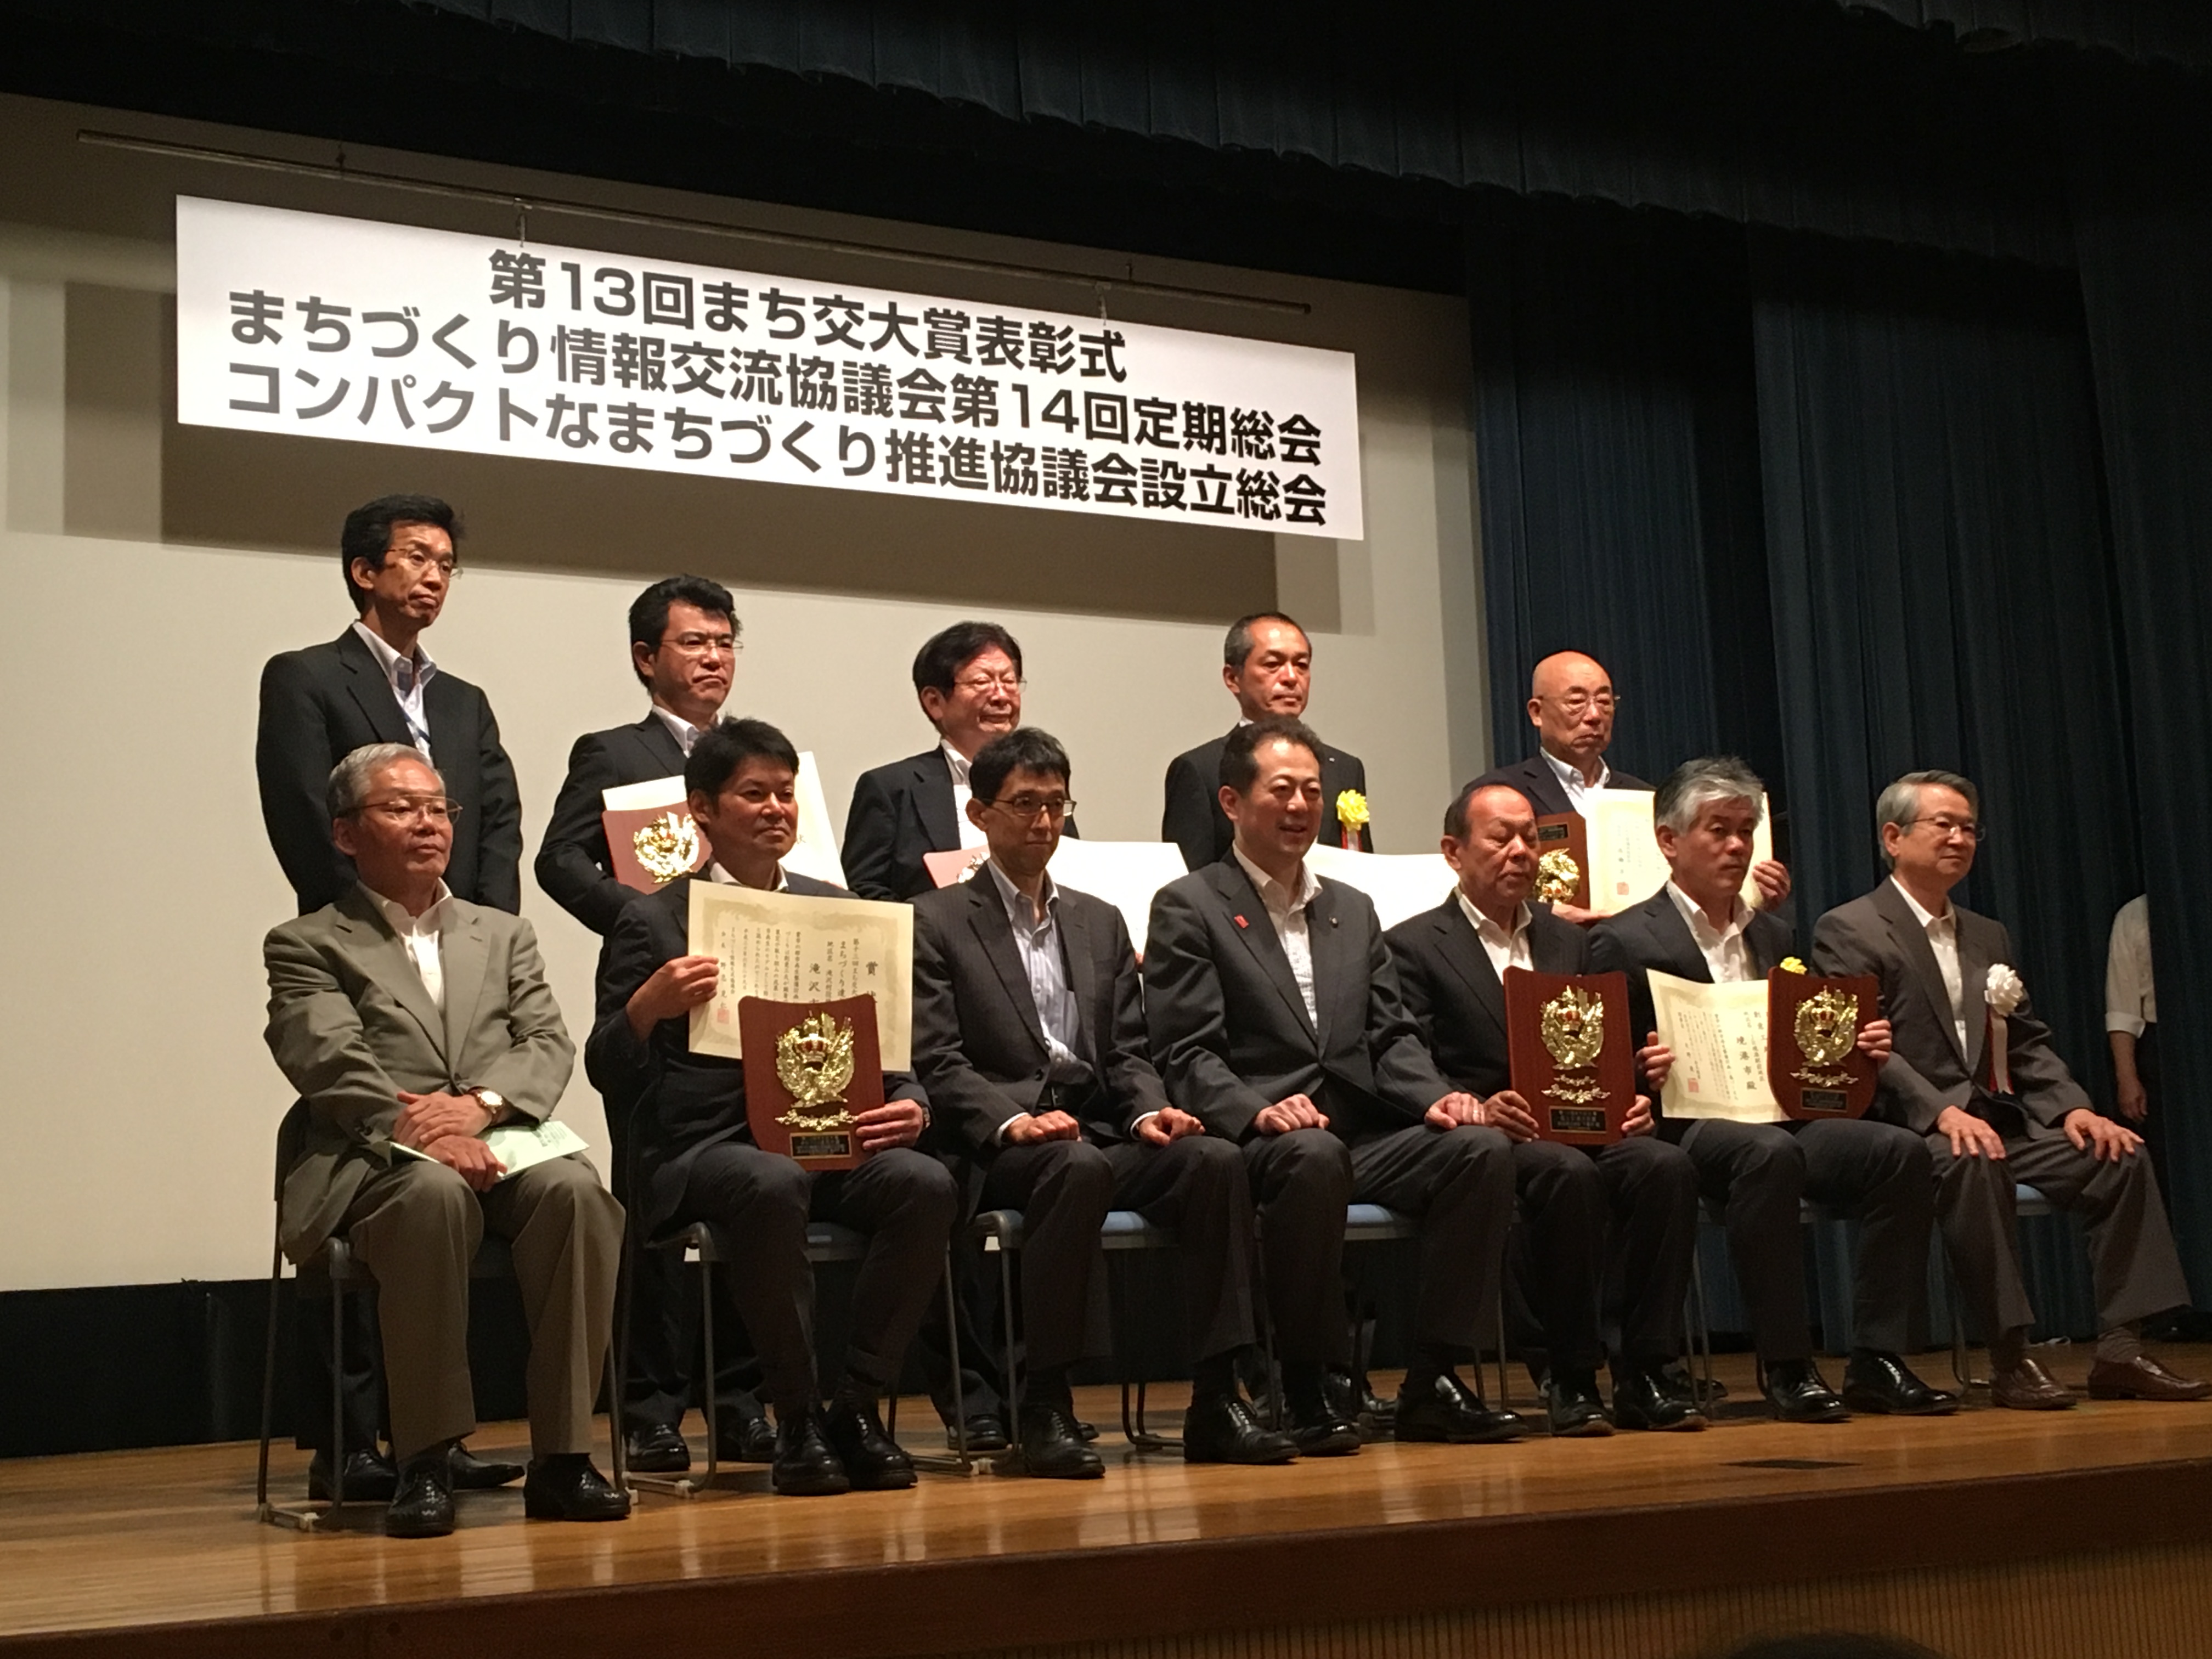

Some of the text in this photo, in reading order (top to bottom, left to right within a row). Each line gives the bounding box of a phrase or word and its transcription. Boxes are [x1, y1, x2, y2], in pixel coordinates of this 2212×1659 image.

[229, 289, 1321, 466] まちづくり情報交流協議会第14回定期総会
[489, 249, 1127, 382] 第13回まち交大賞表彰式
[229, 362, 1327, 526] コンパクトなまちづくり推進協議会設立総会
